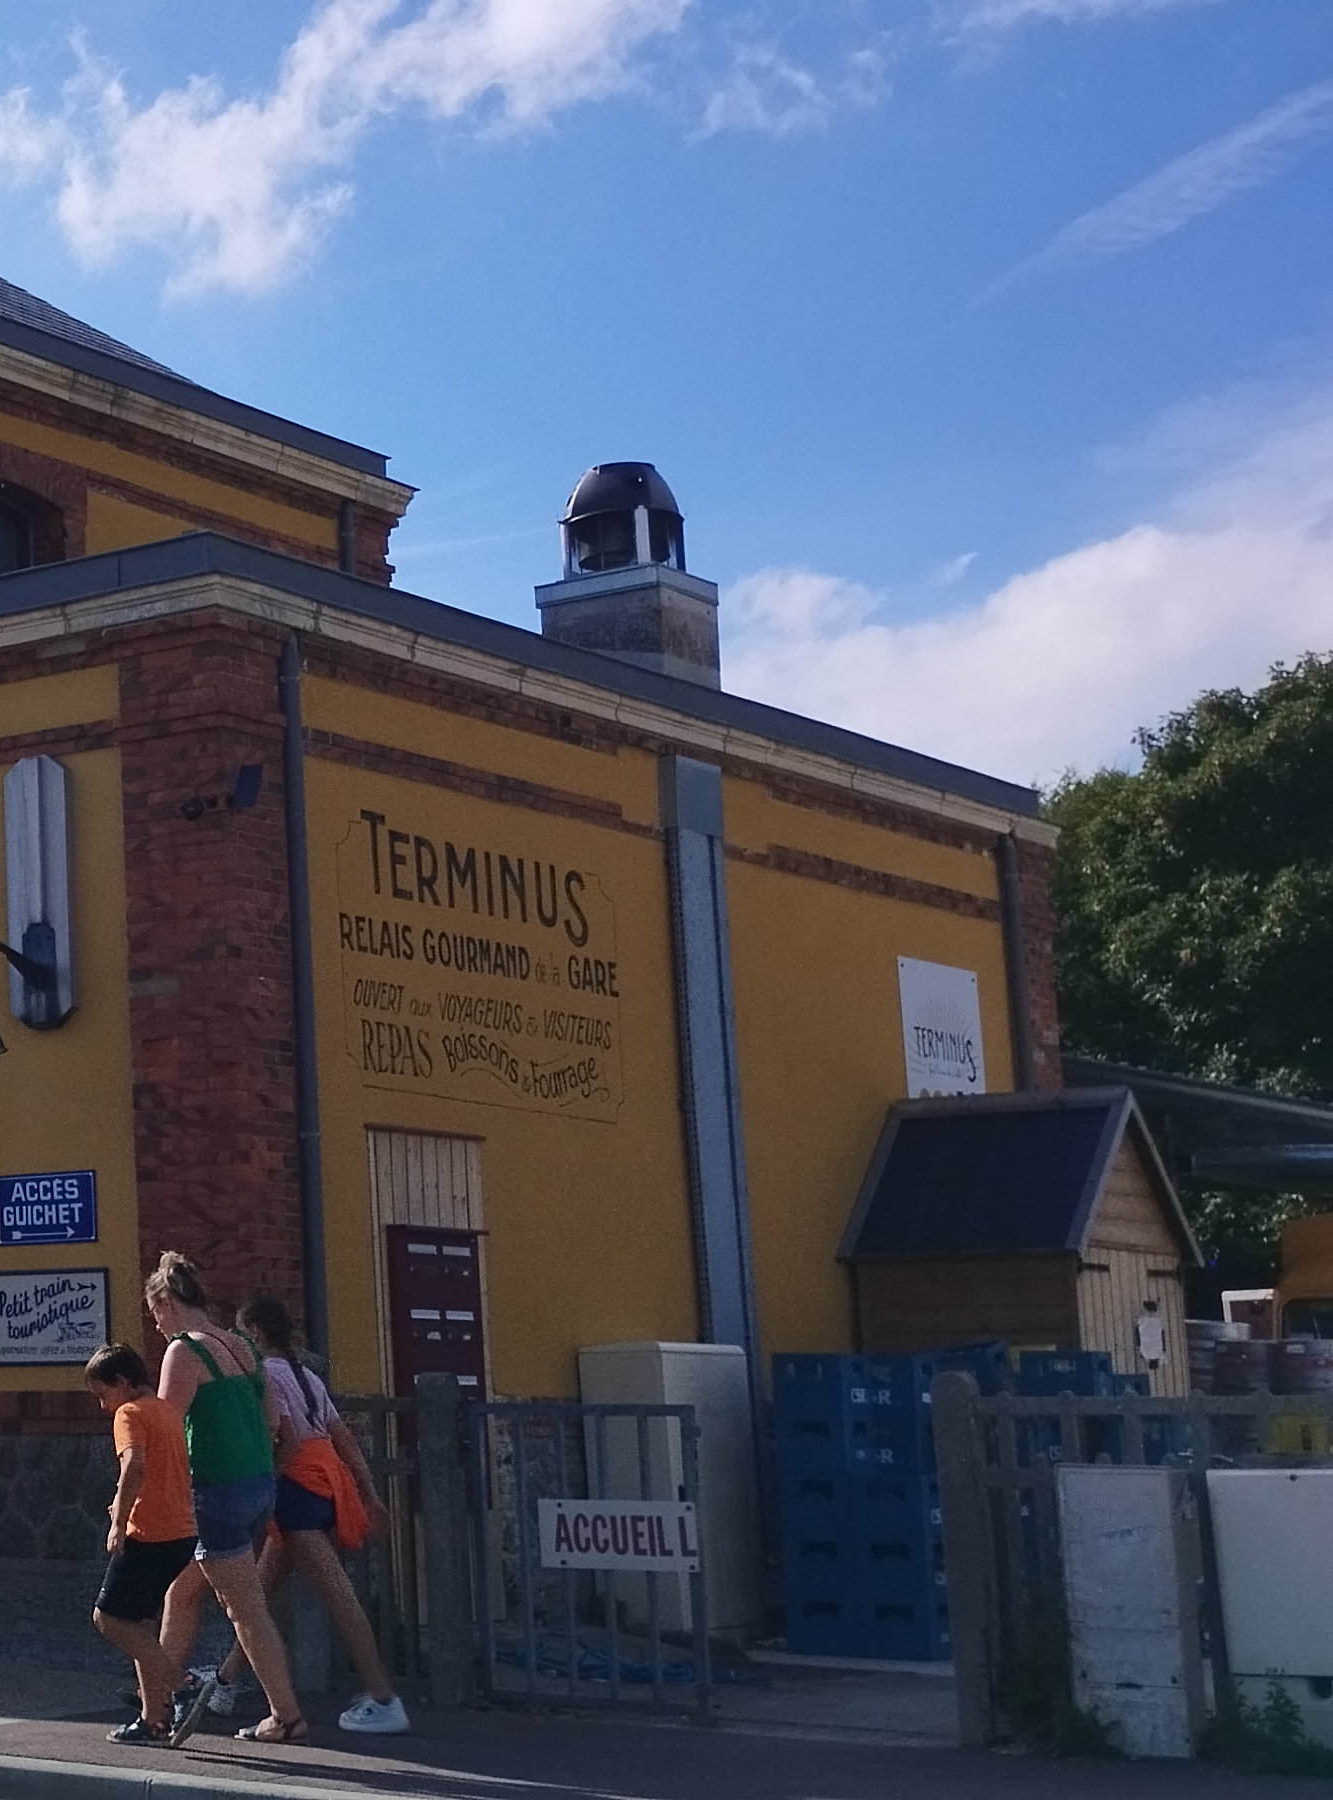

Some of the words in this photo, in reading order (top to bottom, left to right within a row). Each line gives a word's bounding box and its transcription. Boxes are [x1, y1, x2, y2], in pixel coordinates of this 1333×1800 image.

[359, 808, 589, 948] TERMINUS
[339, 912, 414, 961] RELAIS
[422, 928, 530, 981] GOURMAND
[567, 955, 620, 998] GARE
[353, 978, 405, 1015] OUVERT
[437, 992, 524, 1038] VOYAGEURS
[543, 1009, 613, 1052] VISITEURS
[360, 1018, 434, 1079] REPAS
[913, 1025, 977, 1083] TERMINUS
[2, 1203, 83, 1226] GUICHET
[11, 1178, 79, 1203] ACCÈS
[7, 1295, 95, 1339] touristique
[33, 1277, 75, 1306] train
[555, 1513, 674, 1558] ACCUEIL
[677, 1516, 698, 1558] L
